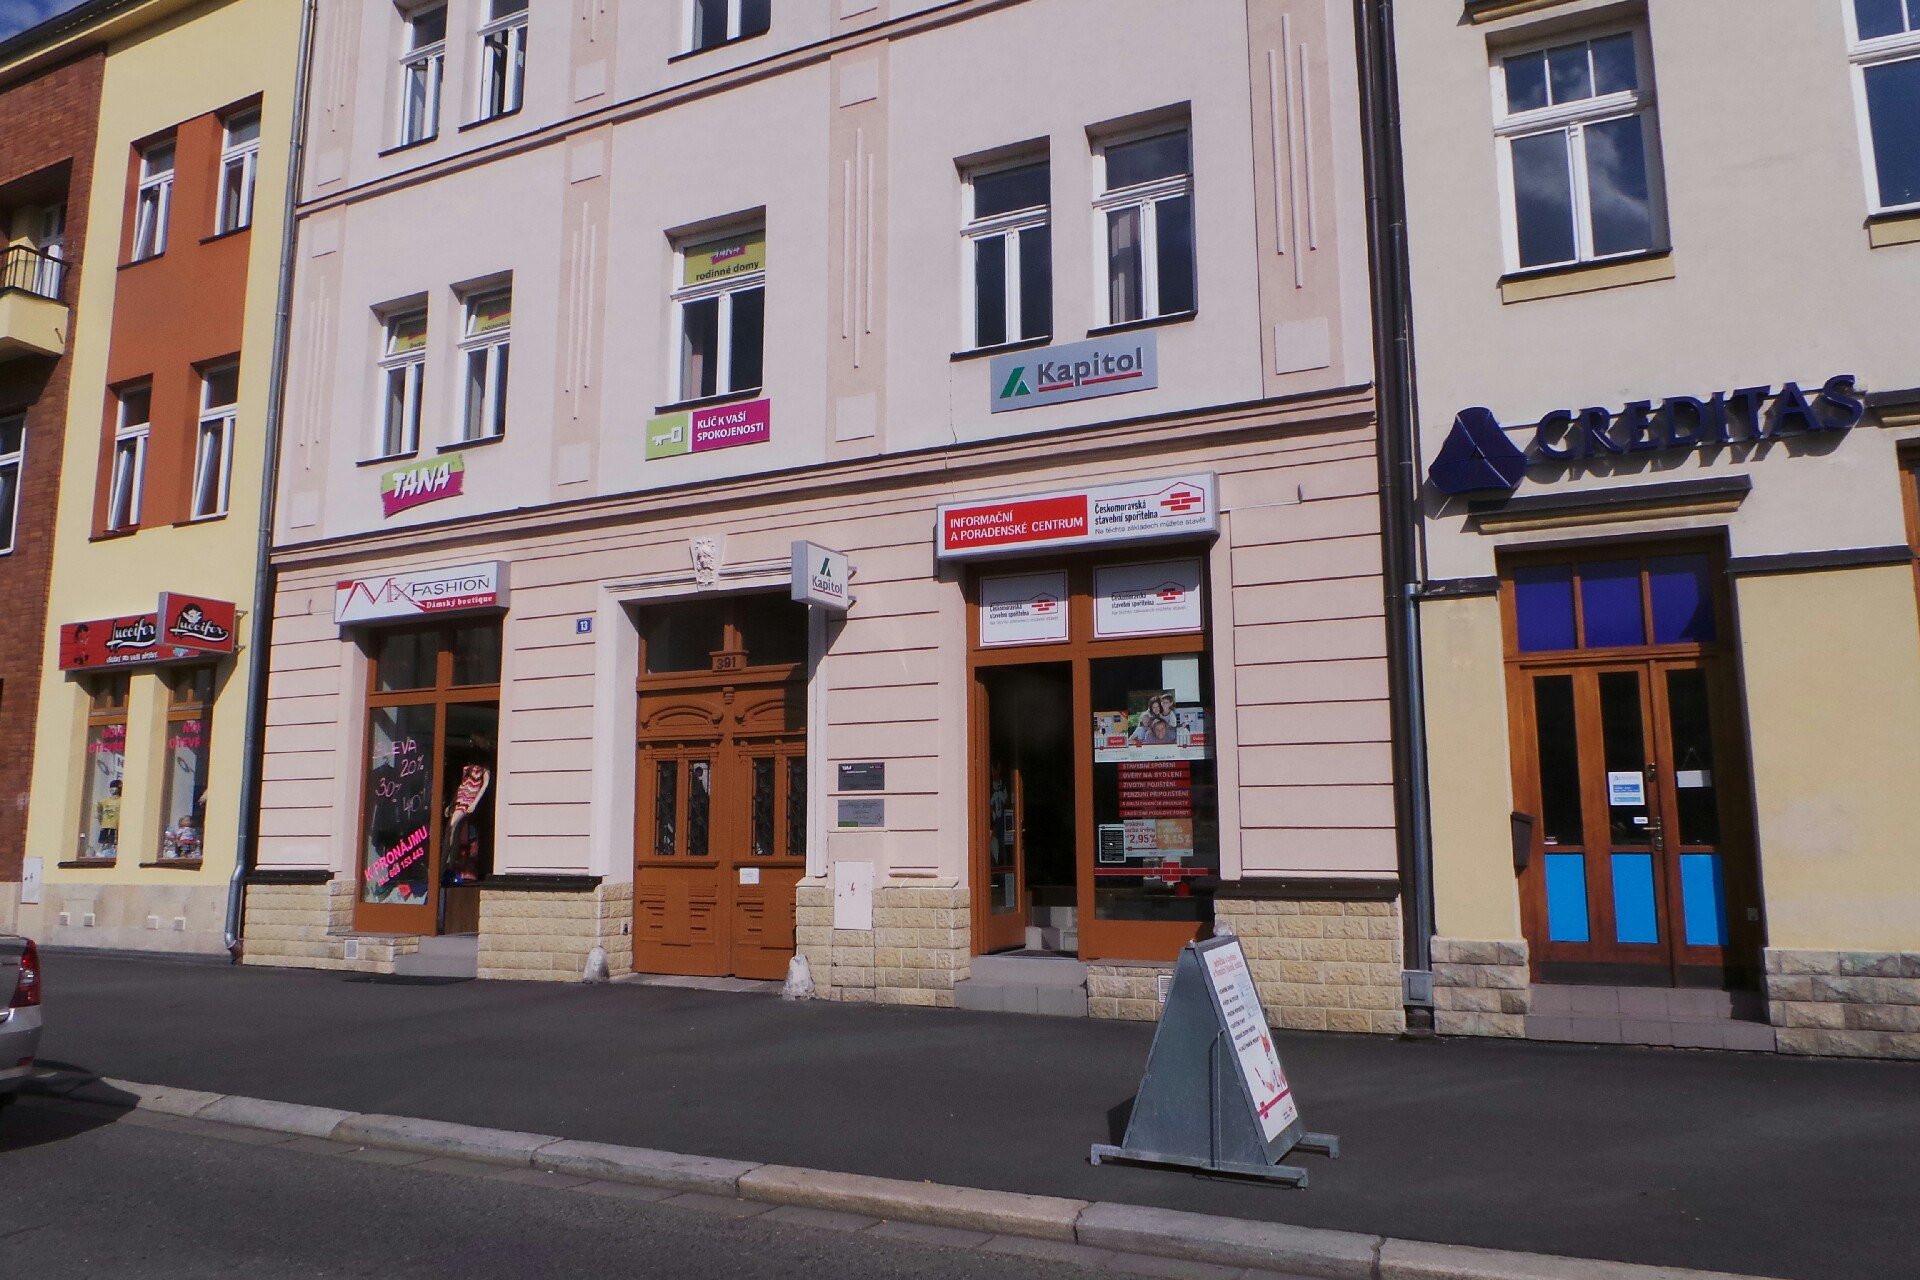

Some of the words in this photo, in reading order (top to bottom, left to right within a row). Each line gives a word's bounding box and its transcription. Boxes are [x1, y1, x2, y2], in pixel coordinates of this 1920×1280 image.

[696, 265, 731, 280] rodinné
[733, 261, 759, 273] domy
[1037, 347, 1143, 386] Kapitol
[697, 416, 717, 429] KLÍČ
[718, 416, 726, 425] K
[726, 411, 747, 424] VAŠÍ
[1536, 374, 1864, 460] CREDITAS
[697, 422, 765, 442] SPOKOJENOSTI
[393, 462, 450, 500] TANA
[1094, 500, 1147, 515] Českomoravská
[950, 510, 1014, 528] INFORMAČNÍ
[1094, 512, 1123, 526] stavební
[1124, 509, 1158, 524] spořitelna
[950, 531, 958, 542] A
[960, 522, 1028, 540] PORADENSKÉ
[1031, 516, 1084, 532] CENTRUM
[812, 575, 843, 595] Kapitol
[426, 599, 456, 609] Dámský
[457, 595, 493, 606] boutique
[580, 620, 588, 631] 13
[716, 657, 736, 670] 391
[400, 754, 424, 777] 20%
[375, 777, 401, 802] 30%
[1130, 834, 1149, 845] 2,95
[364, 866, 374, 881] K
[373, 825, 429, 875] PRONÁJMU
